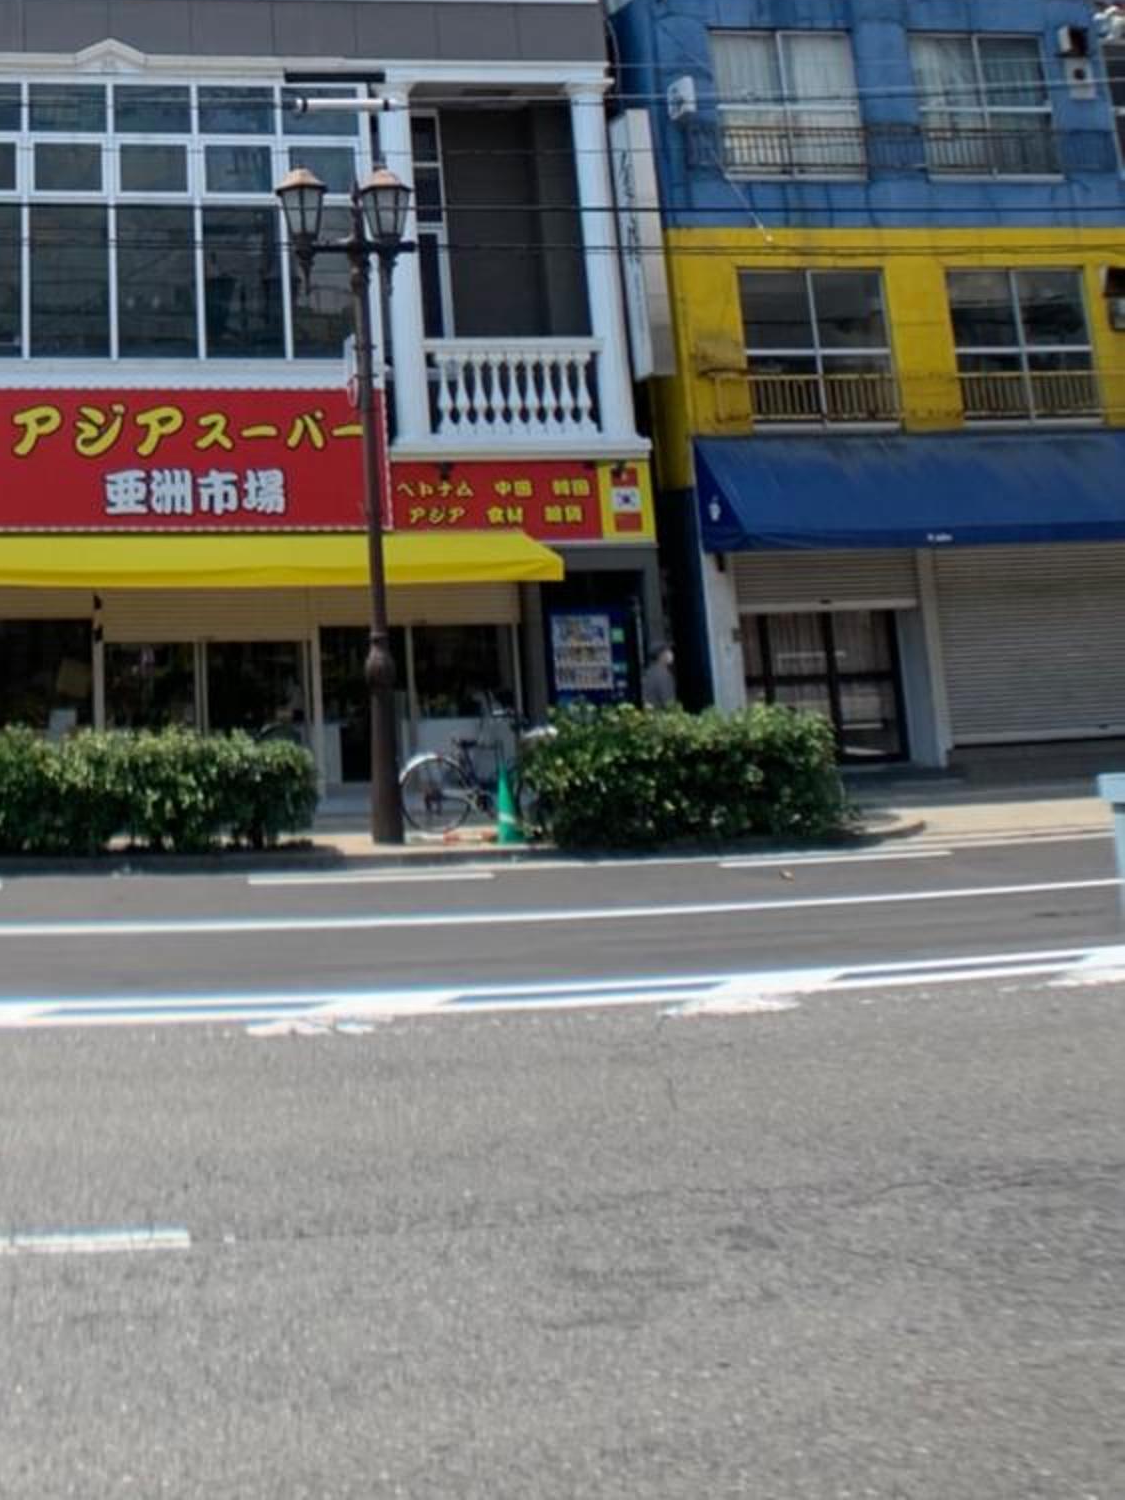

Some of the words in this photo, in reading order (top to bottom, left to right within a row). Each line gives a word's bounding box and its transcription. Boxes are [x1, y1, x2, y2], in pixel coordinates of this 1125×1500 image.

[12, 404, 364, 457] アジアスーパー
